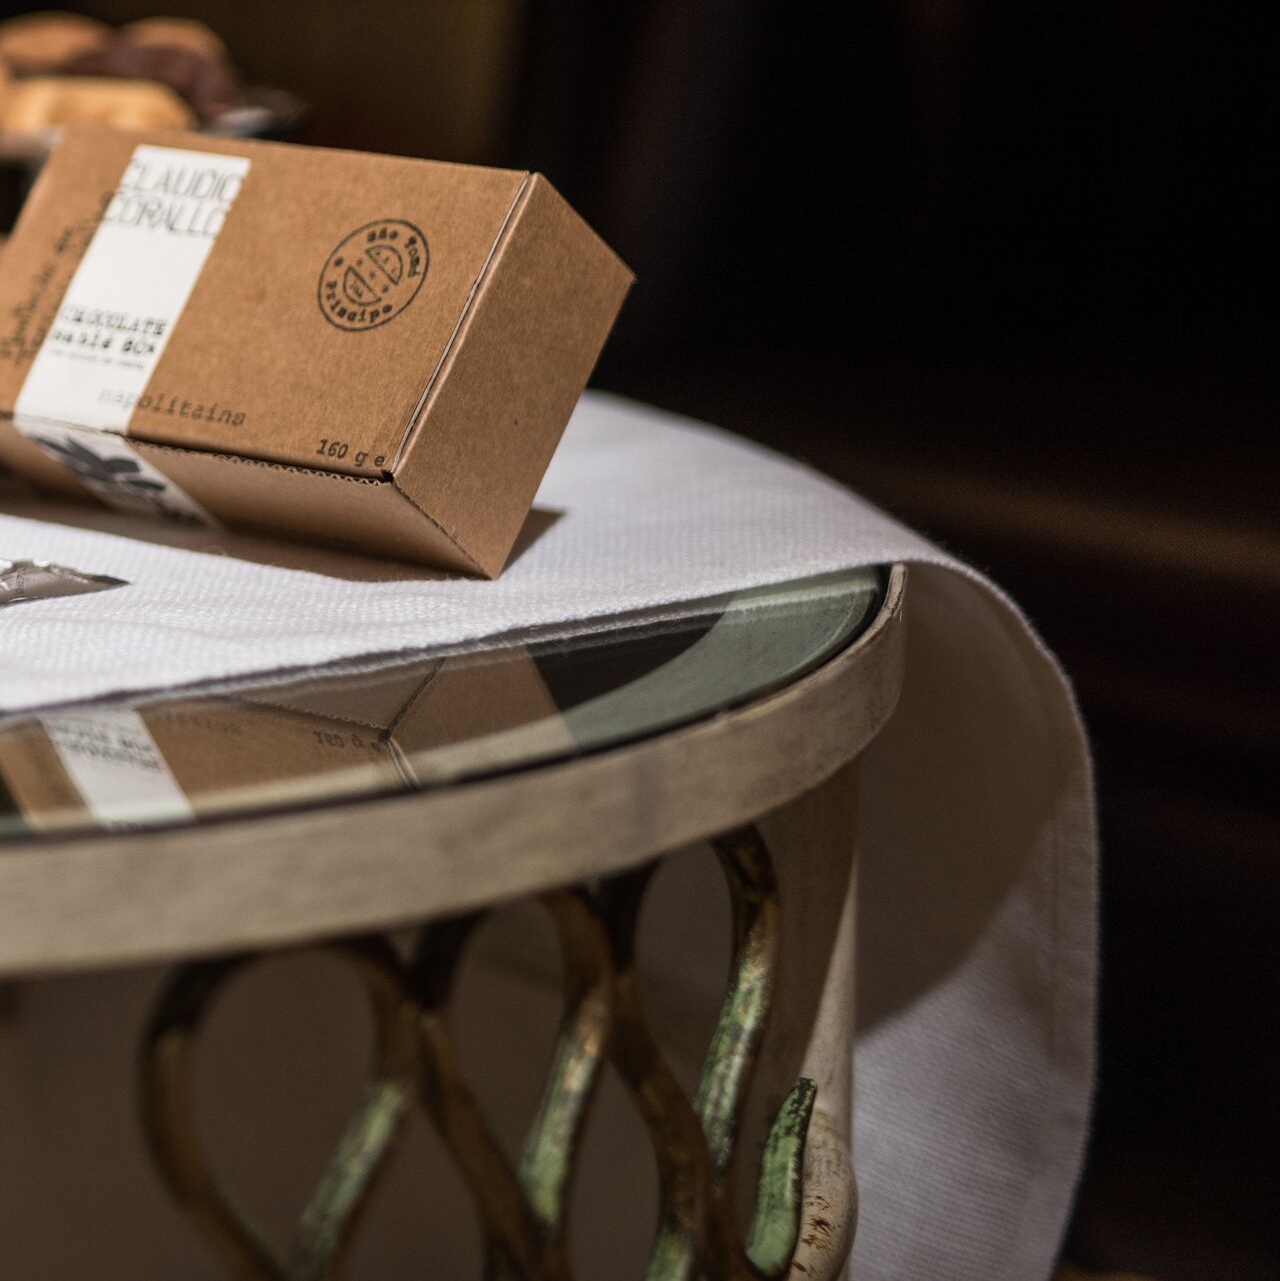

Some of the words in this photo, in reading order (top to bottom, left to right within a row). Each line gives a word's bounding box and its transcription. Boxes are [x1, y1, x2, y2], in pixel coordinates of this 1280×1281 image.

[98, 387, 247, 427] napolitains
[316, 438, 349, 460] 160
[354, 451, 368, 467] g
